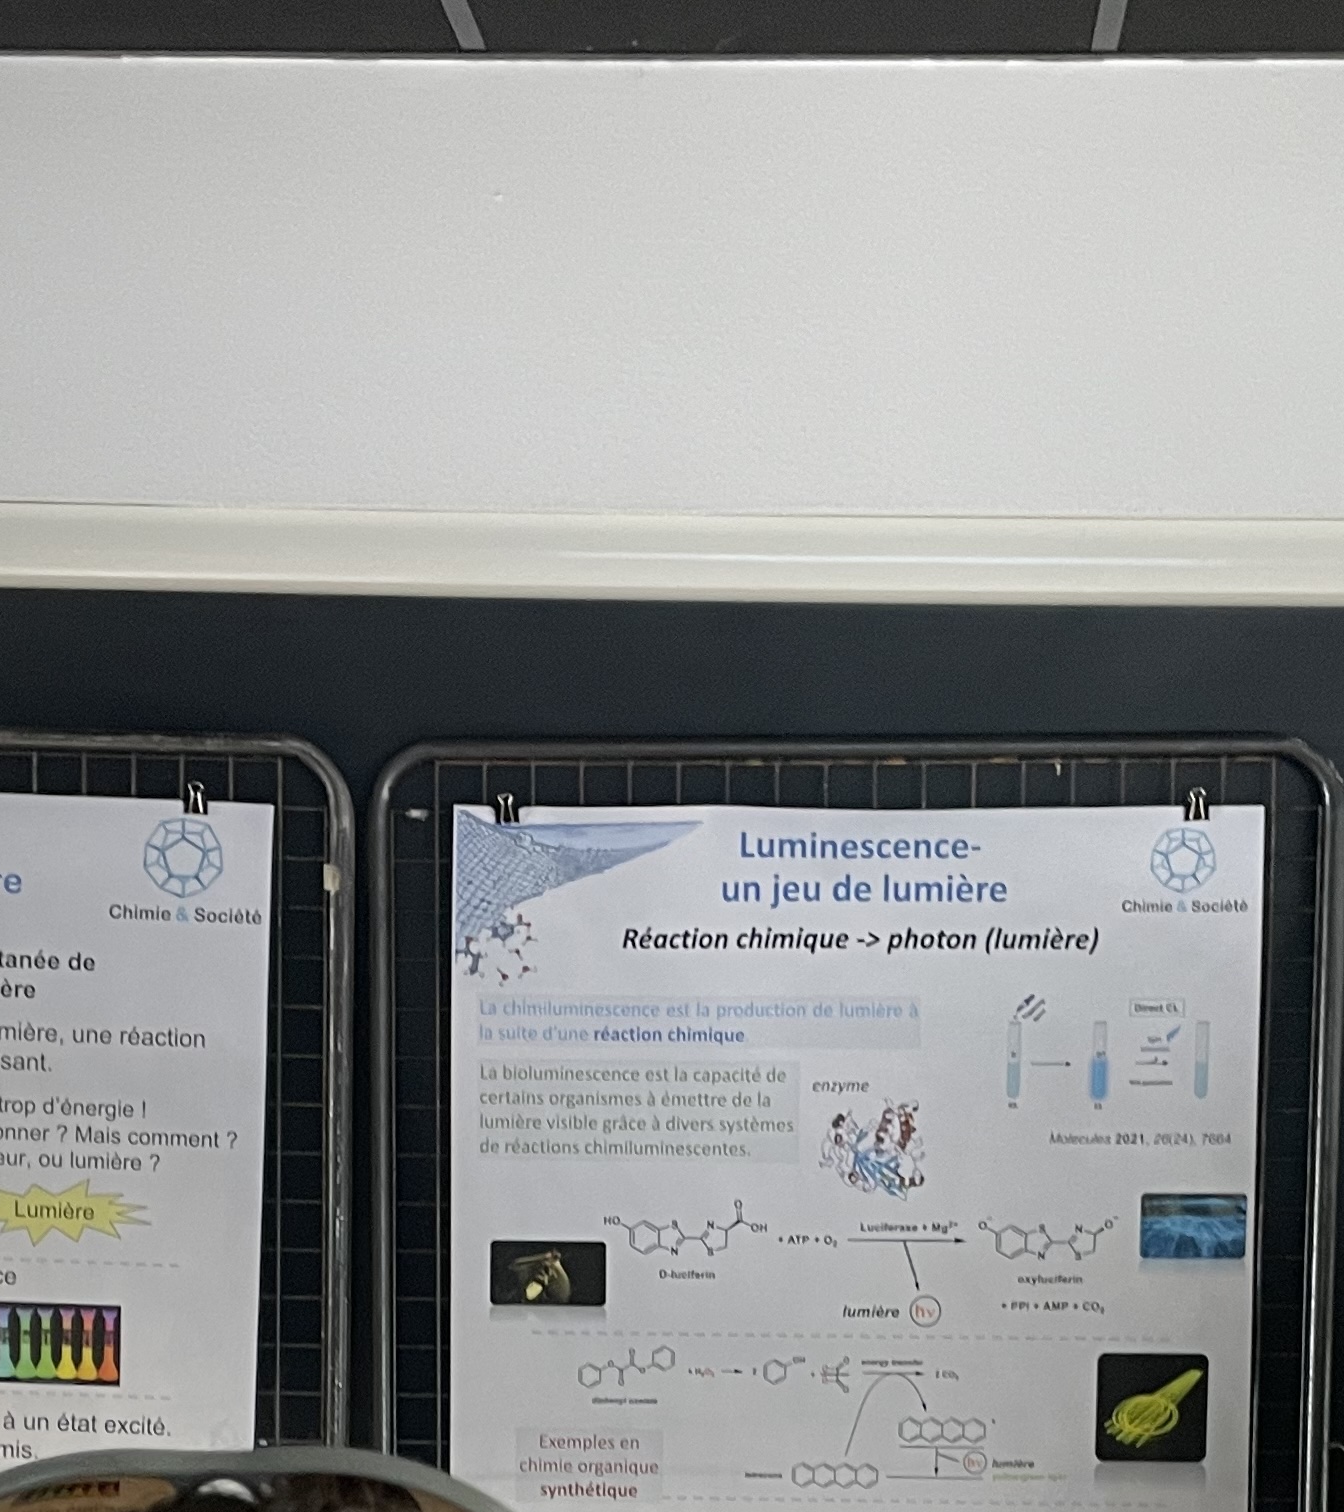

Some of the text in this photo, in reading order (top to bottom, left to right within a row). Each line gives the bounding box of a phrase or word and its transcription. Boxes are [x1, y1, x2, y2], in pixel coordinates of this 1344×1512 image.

[740, 831, 981, 860] Luminescence-
[722, 874, 1008, 909] un jeu de lumière
[109, 904, 262, 924] Chimie & Société
[1122, 900, 1172, 913] Chimie
[1192, 899, 1248, 913] Société
[622, 926, 728, 950] Réaction
[736, 927, 848, 955] chimique
[887, 927, 976, 955] photon
[985, 926, 1099, 954] (lumière)
[68, 952, 96, 972] de
[479, 1003, 497, 1016] La
[503, 1001, 660, 1018] chimiluminescence
[666, 1003, 689, 1018] est
[696, 1002, 710, 1018] la
[716, 1003, 805, 1021] production
[812, 1003, 832, 1018] de
[840, 1003, 902, 1019] lumière
[72, 1029, 112, 1045] une
[120, 1025, 206, 1048] réaction
[479, 1026, 745, 1045] la suite d'une réaction chimique
[480, 1065, 786, 1086] La bioluminescence est la capacité de
[812, 1079, 869, 1094] enzyme
[480, 1089, 771, 1109] certains organismes à émettre de la
[43, 1097, 134, 1122] d'énergie
[142, 1101, 146, 1119] !
[480, 1114, 541, 1130] lumière
[546, 1114, 597, 1130] visible
[603, 1115, 646, 1134] grâce
[665, 1116, 714, 1132] divers
[719, 1117, 794, 1136] systèmes
[57, 1126, 67, 1142] ?
[75, 1126, 121, 1145] Mais
[127, 1130, 219, 1149] comment
[227, 1132, 237, 1148] ?
[480, 1138, 751, 1157] de réactions chimiluminescentes.
[38, 1153, 62, 1168] ou
[70, 1152, 142, 1171] lumière
[150, 1154, 160, 1172] ?
[15, 1200, 94, 1220] Lumière
[843, 1305, 900, 1318] lumière
[3, 1411, 15, 1430] à
[24, 1415, 49, 1431] un
[57, 1413, 97, 1433] état
[105, 1415, 172, 1437] excité.
[540, 1434, 639, 1452] Exemples en
[520, 1457, 658, 1476] chimie organique
[540, 1481, 637, 1500] synthétique
